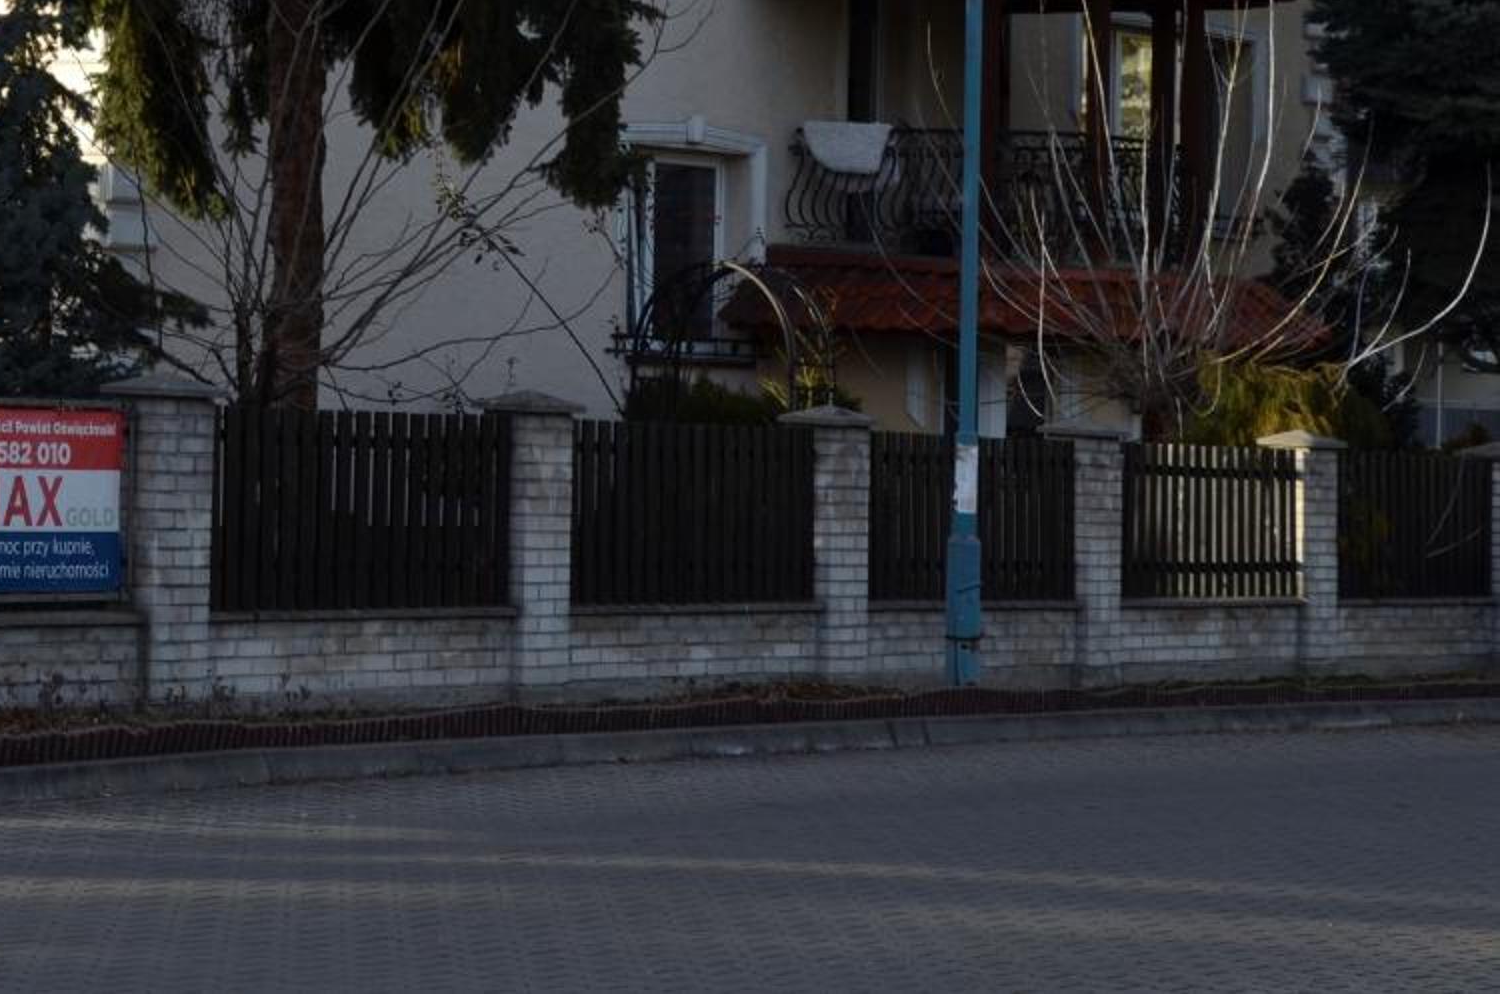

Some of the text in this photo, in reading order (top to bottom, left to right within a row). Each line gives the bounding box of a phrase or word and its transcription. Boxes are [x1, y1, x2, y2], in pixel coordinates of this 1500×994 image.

[37, 442, 71, 465] 010
[66, 507, 116, 527] GOLD
[23, 541, 49, 558] przy
